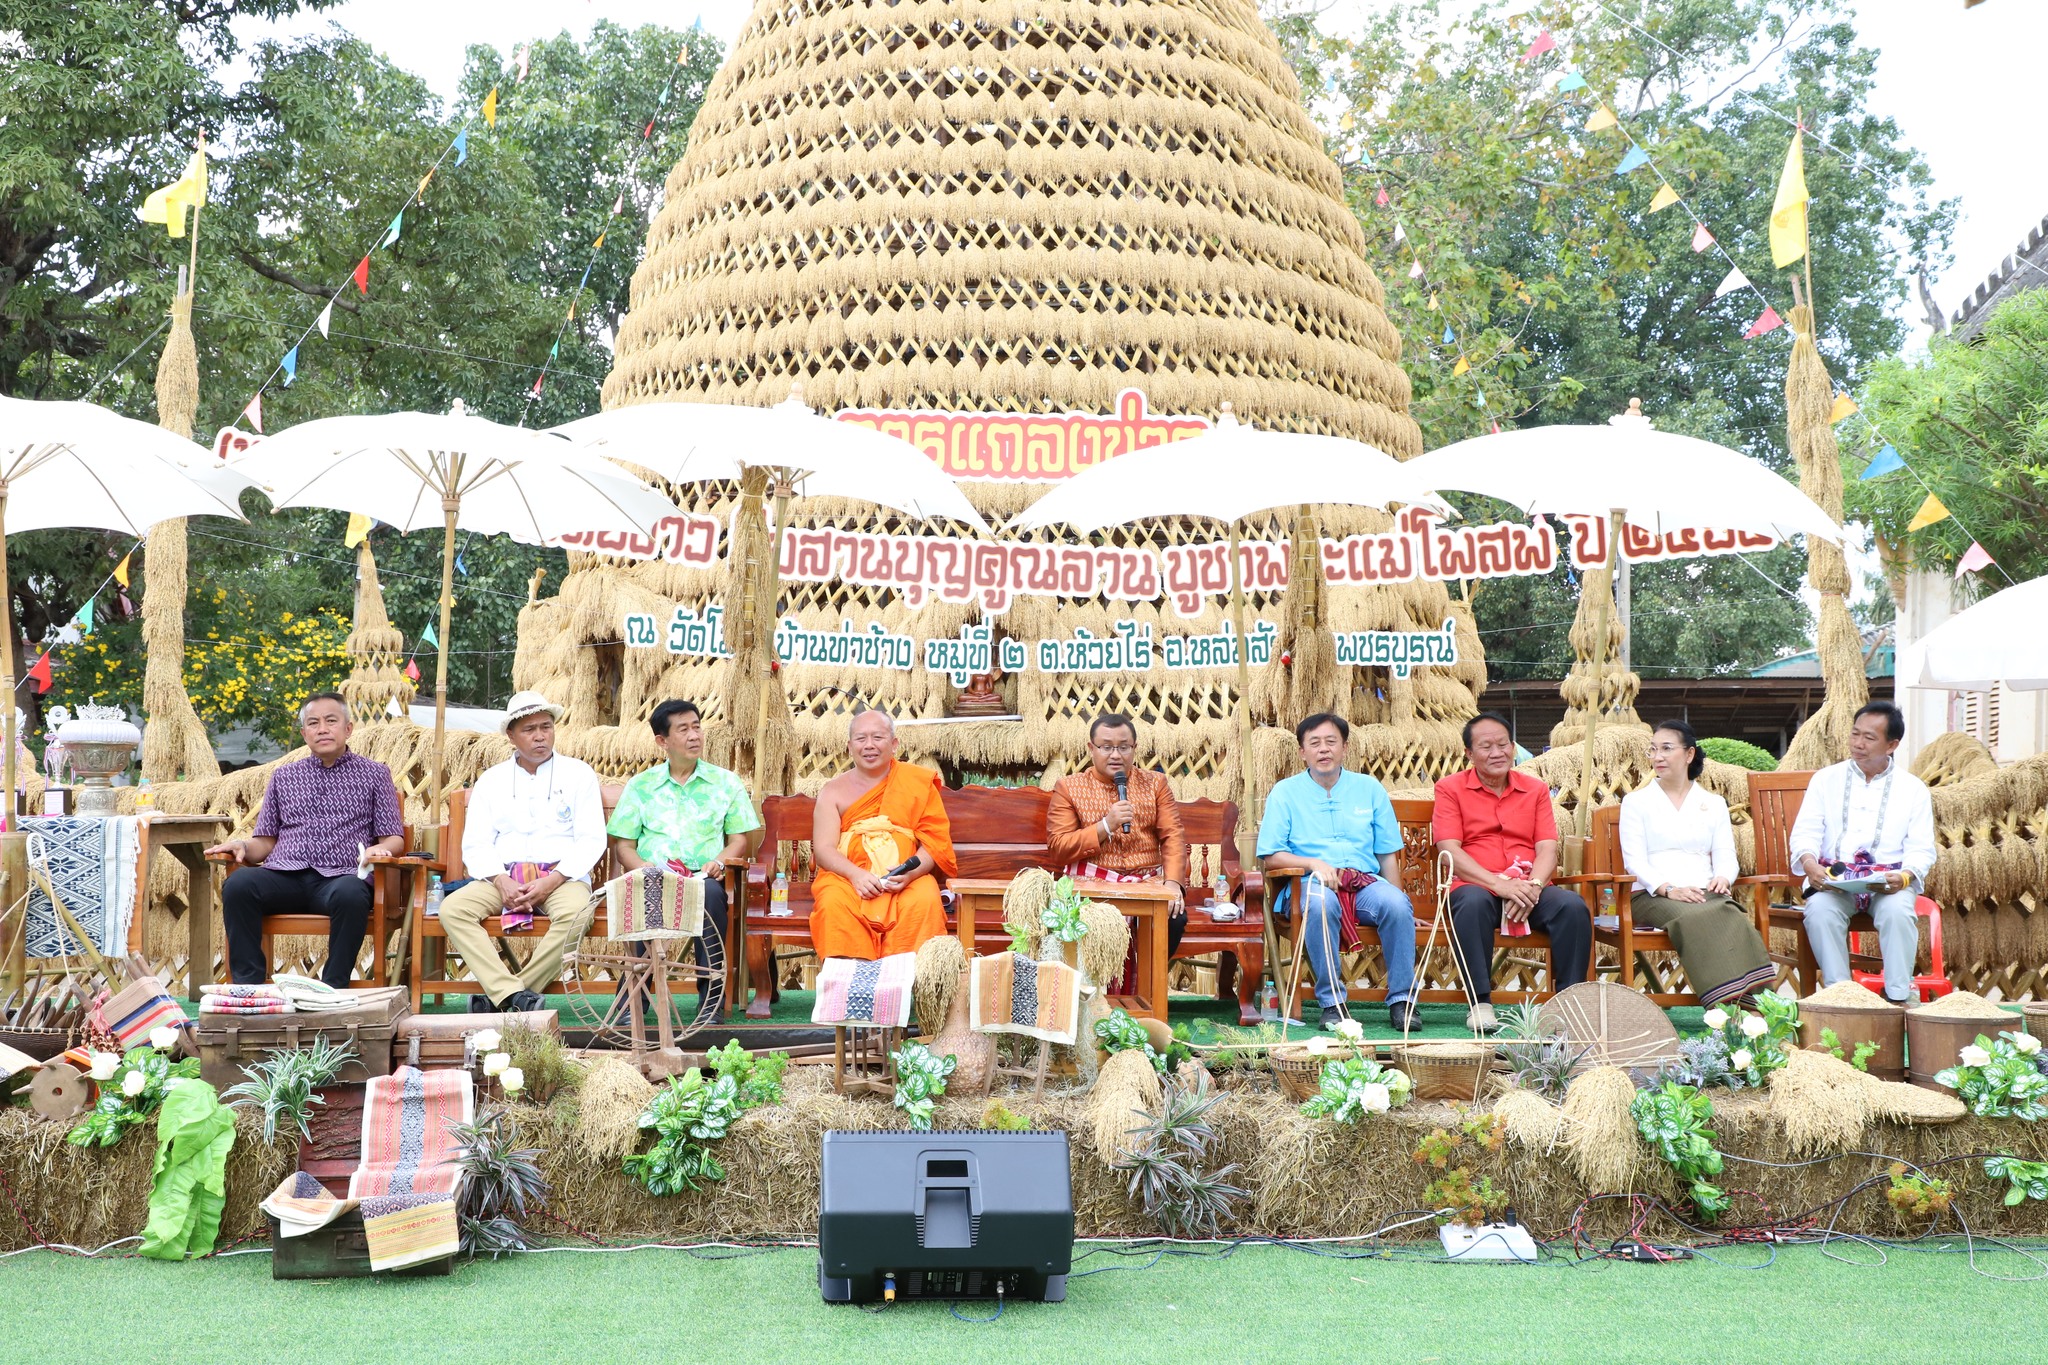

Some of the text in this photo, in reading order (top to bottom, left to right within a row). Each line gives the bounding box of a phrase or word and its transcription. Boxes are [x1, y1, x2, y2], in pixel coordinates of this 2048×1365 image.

[844, 397, 1203, 474] รแถลงข่
[1166, 507, 1552, 614] บูชาพะแม่โพสพ
[627, 616, 655, 644] ณ
[777, 618, 911, 667] บ้านท่าช้าง
[928, 616, 990, 684] หมู่ที่
[1002, 638, 1025, 669] ๒
[1041, 622, 1150, 670] ต.ห้วยไร่
[1337, 620, 1454, 677] พชรบูรณ์
